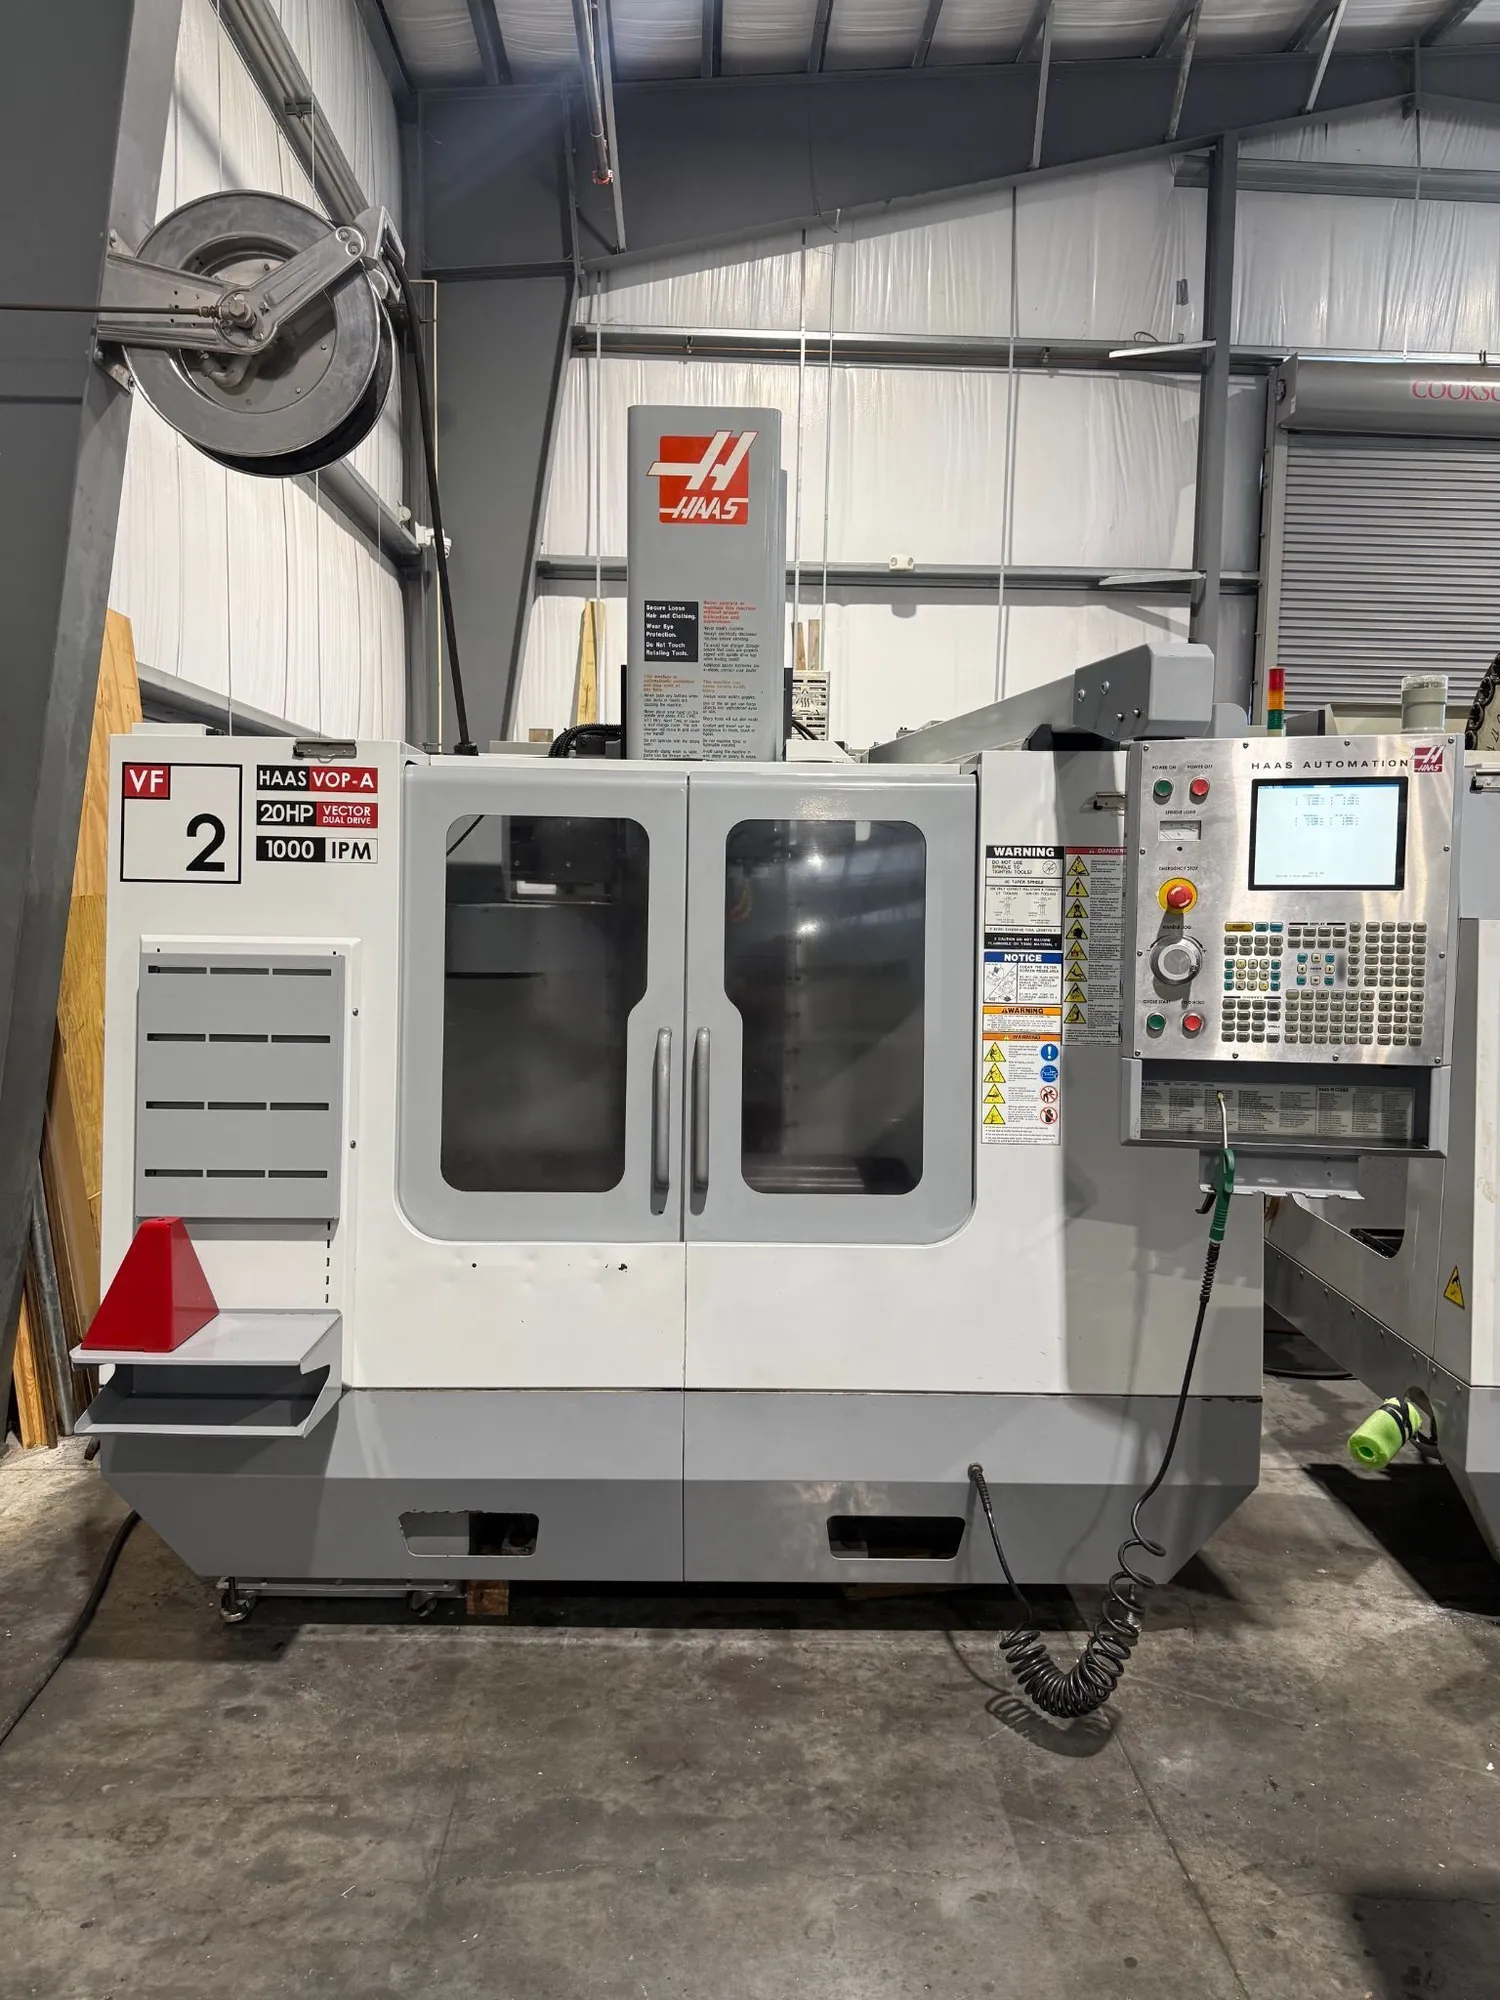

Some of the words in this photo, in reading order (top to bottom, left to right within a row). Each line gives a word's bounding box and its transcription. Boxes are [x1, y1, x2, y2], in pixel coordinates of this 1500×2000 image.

[660, 496, 748, 519] HAAS
[1251, 762, 1294, 770] HAAS
[1303, 759, 1409, 769] AUTOMATION
[129, 769, 164, 793] VF
[259, 770, 307, 787] HAAS
[312, 772, 375, 789] VOP-A
[260, 804, 314, 823] 20HP
[322, 805, 371, 817] VECTOR
[322, 816, 345, 825] DUAL
[347, 817, 371, 825] DRIVE
[185, 813, 226, 872] 2
[265, 840, 315, 859] 1000
[331, 841, 372, 860] IPM
[994, 847, 1055, 857] WARNING
[1004, 953, 1042, 962] NOTICE
